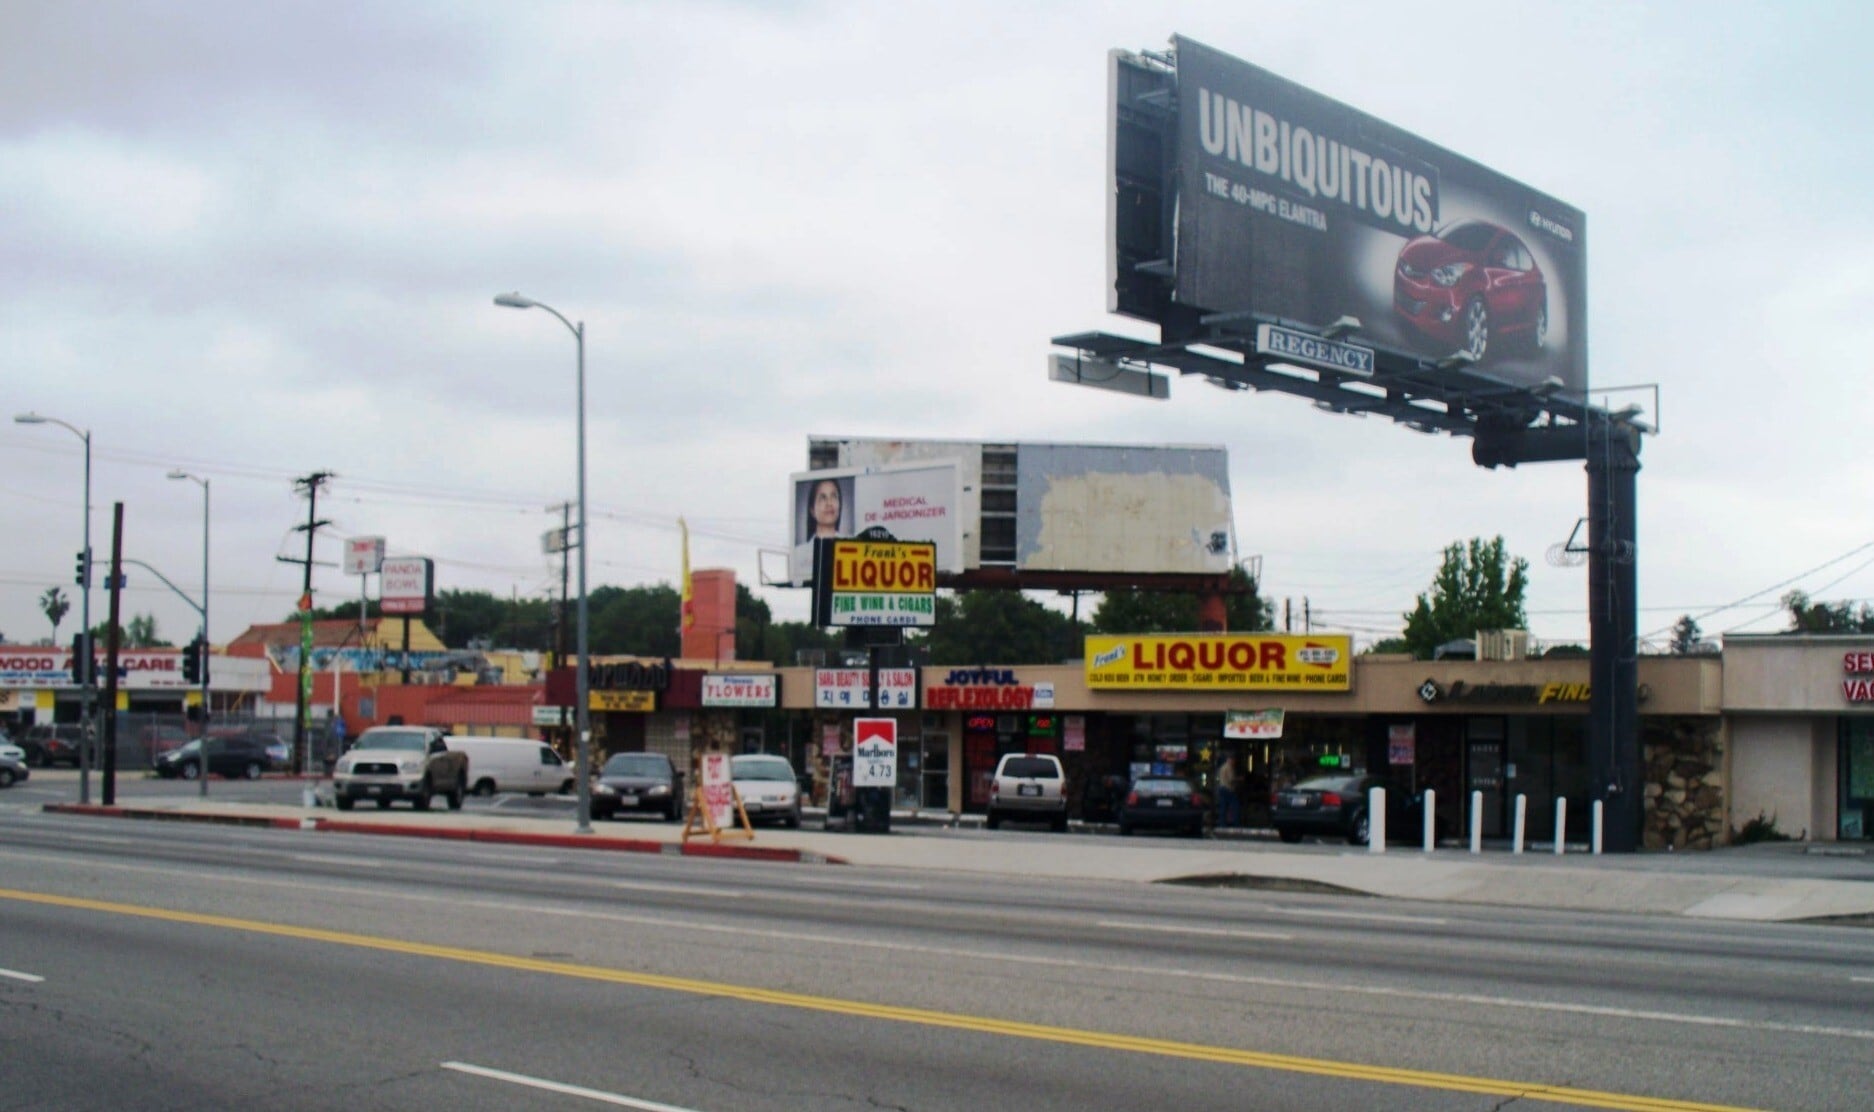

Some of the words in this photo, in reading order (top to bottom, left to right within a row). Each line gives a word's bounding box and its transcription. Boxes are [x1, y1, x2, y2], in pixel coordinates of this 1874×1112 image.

[1205, 172, 1229, 199] THE
[1231, 184, 1277, 216] 40-MPG
[1279, 200, 1327, 233] ELANTRA
[1270, 330, 1369, 370] REGENCY
[883, 496, 926, 508] MEDICAL
[863, 545, 907, 558] Frank's
[384, 564, 422, 574] PANDA
[836, 560, 933, 588] LIQUOR
[386, 579, 418, 590] BOWL
[834, 596, 856, 614] FINE
[861, 596, 884, 610] WINE
[898, 597, 932, 614] CIGARS
[851, 616, 882, 624] PHONE
[887, 616, 917, 624] CARDS
[1133, 641, 1286, 671] LIQUOR
[1844, 652, 1874, 672] SE
[123, 658, 175, 671] CARE
[836, 671, 859, 687] BEAUTY
[893, 671, 913, 686] SALON
[945, 669, 1019, 685] JOYFUL
[707, 685, 772, 699] FLOWERS
[926, 686, 1034, 709] REFLEXOLOGY
[968, 717, 994, 728] OPEN
[858, 745, 894, 758] Marlboro
